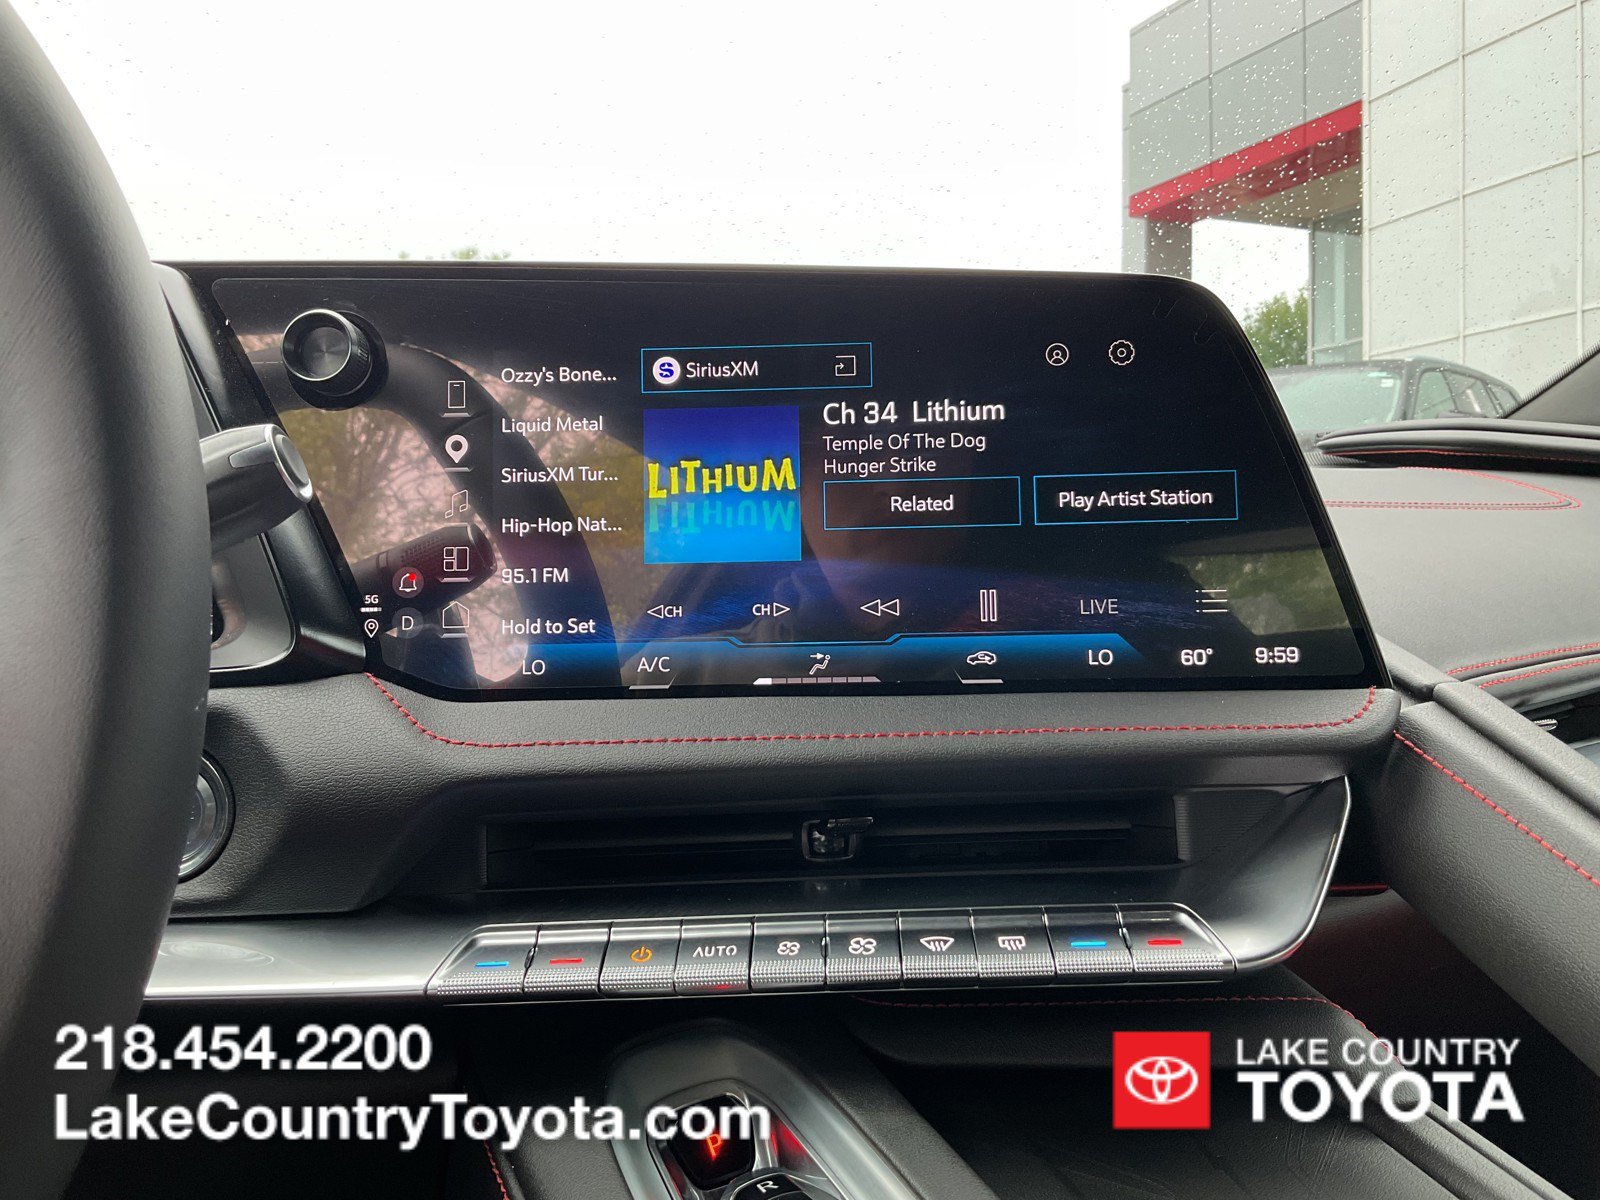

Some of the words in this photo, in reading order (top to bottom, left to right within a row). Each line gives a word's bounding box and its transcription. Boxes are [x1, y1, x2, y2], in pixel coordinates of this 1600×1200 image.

[501, 366, 554, 386] Ozzy's
[559, 367, 617, 382] Bone...
[686, 360, 759, 378] SiriusXM
[822, 401, 855, 425] Ch
[863, 401, 898, 425] 34
[913, 399, 1005, 423] Lithium
[501, 416, 551, 436] Liquid
[556, 415, 603, 431] Metal
[822, 434, 883, 454] Temple
[887, 433, 910, 449] Of
[913, 433, 946, 449] The
[951, 432, 986, 451] Dog
[501, 467, 574, 483] SiriusXM
[578, 466, 619, 481] Tur...
[824, 458, 885, 477] Hunger
[890, 456, 936, 473] Strike
[890, 494, 954, 512] Related
[1058, 491, 1093, 511] Play
[1097, 490, 1146, 507] Artist
[1150, 489, 1213, 506] Station
[501, 517, 573, 537] Hip-Hop
[577, 516, 622, 532] Nat...
[501, 568, 537, 583] 95.1
[543, 567, 569, 583] FM
[364, 594, 379, 604] 5G
[1080, 598, 1119, 615] LIVE
[664, 605, 683, 618] CH
[752, 603, 771, 616] CH
[401, 615, 414, 631] D
[501, 618, 541, 635] Hold
[545, 620, 563, 634] to
[567, 618, 596, 633] Set
[637, 656, 671, 672] A/C
[1088, 649, 1114, 665] LO
[1180, 648, 1213, 666] 60°
[1255, 647, 1299, 664] 9:59
[522, 659, 546, 675] LO
[692, 945, 737, 958] AUTO
[705, 1133, 723, 1161] P
[756, 1180, 779, 1194] R
